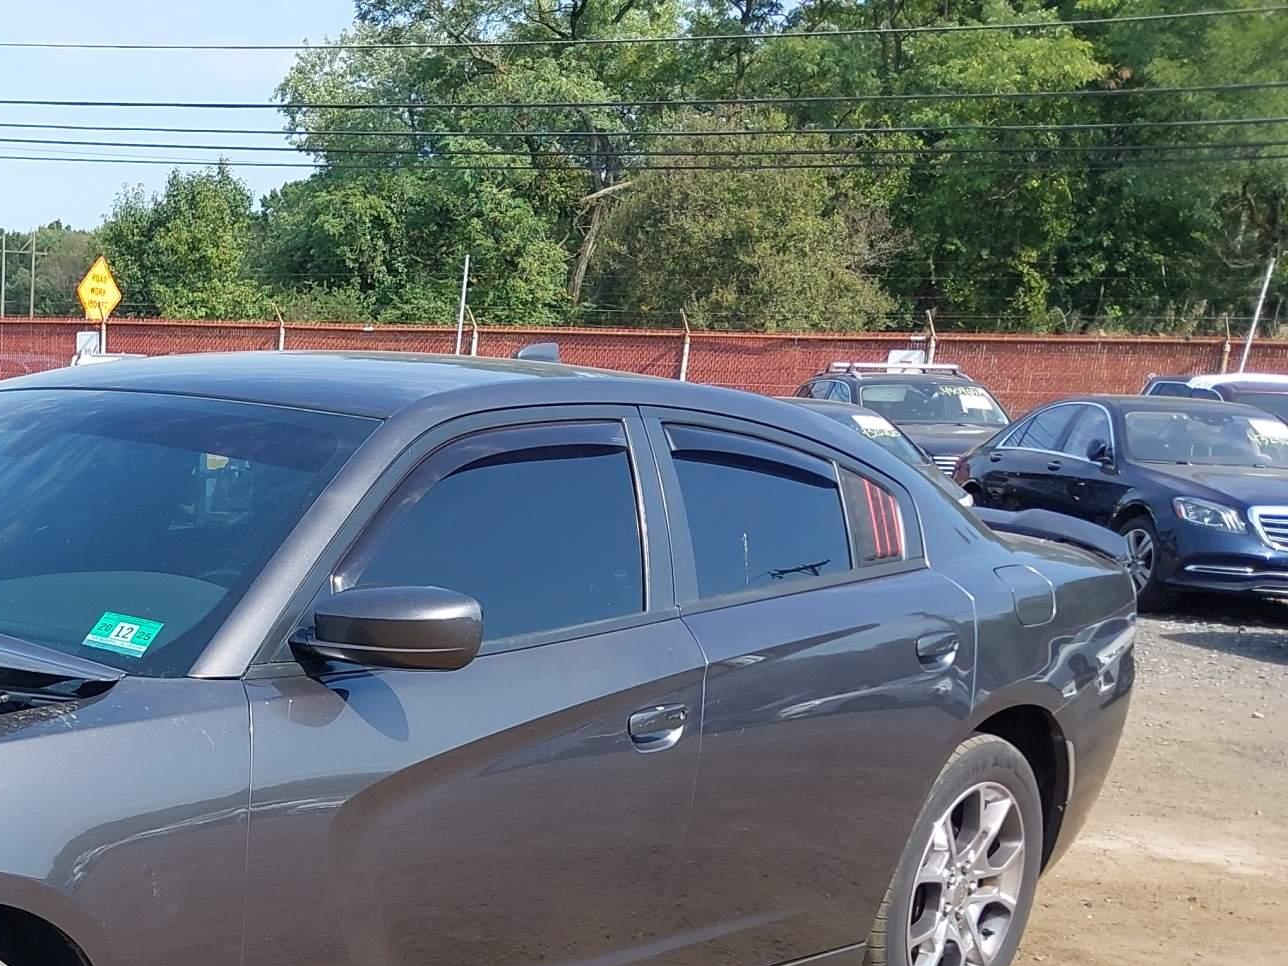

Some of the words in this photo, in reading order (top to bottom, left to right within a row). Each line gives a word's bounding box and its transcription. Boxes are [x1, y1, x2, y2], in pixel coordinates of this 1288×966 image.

[91, 273, 108, 284] ROAD
[90, 287, 106, 297] WORK
[97, 622, 113, 633] 20
[114, 625, 135, 640] 12
[136, 630, 152, 641] 25
